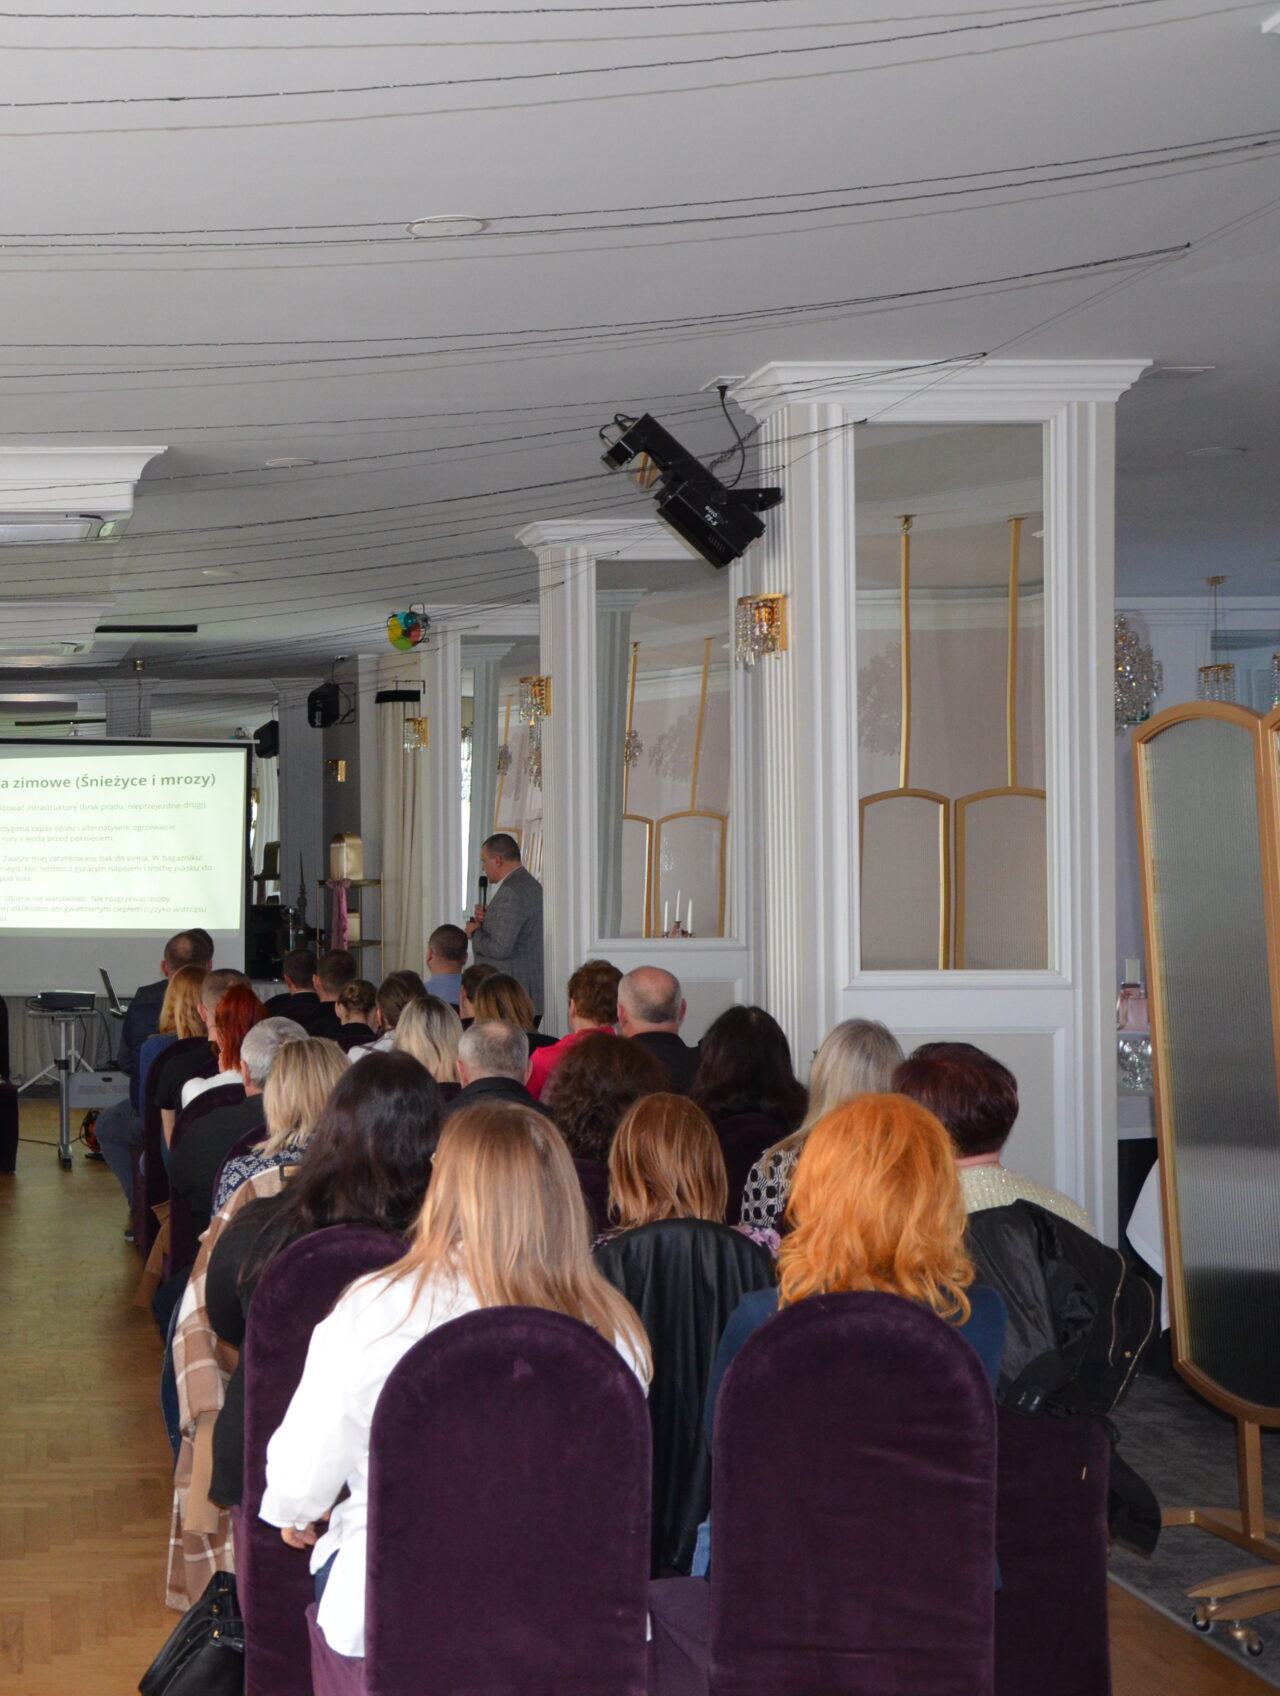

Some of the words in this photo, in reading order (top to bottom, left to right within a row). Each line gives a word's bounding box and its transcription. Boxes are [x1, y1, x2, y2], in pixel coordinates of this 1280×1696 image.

[13, 776, 71, 789] zimowe
[75, 773, 148, 790] (Śnieżyce
[152, 774, 156, 786] i
[160, 773, 216, 789] mrozy)
